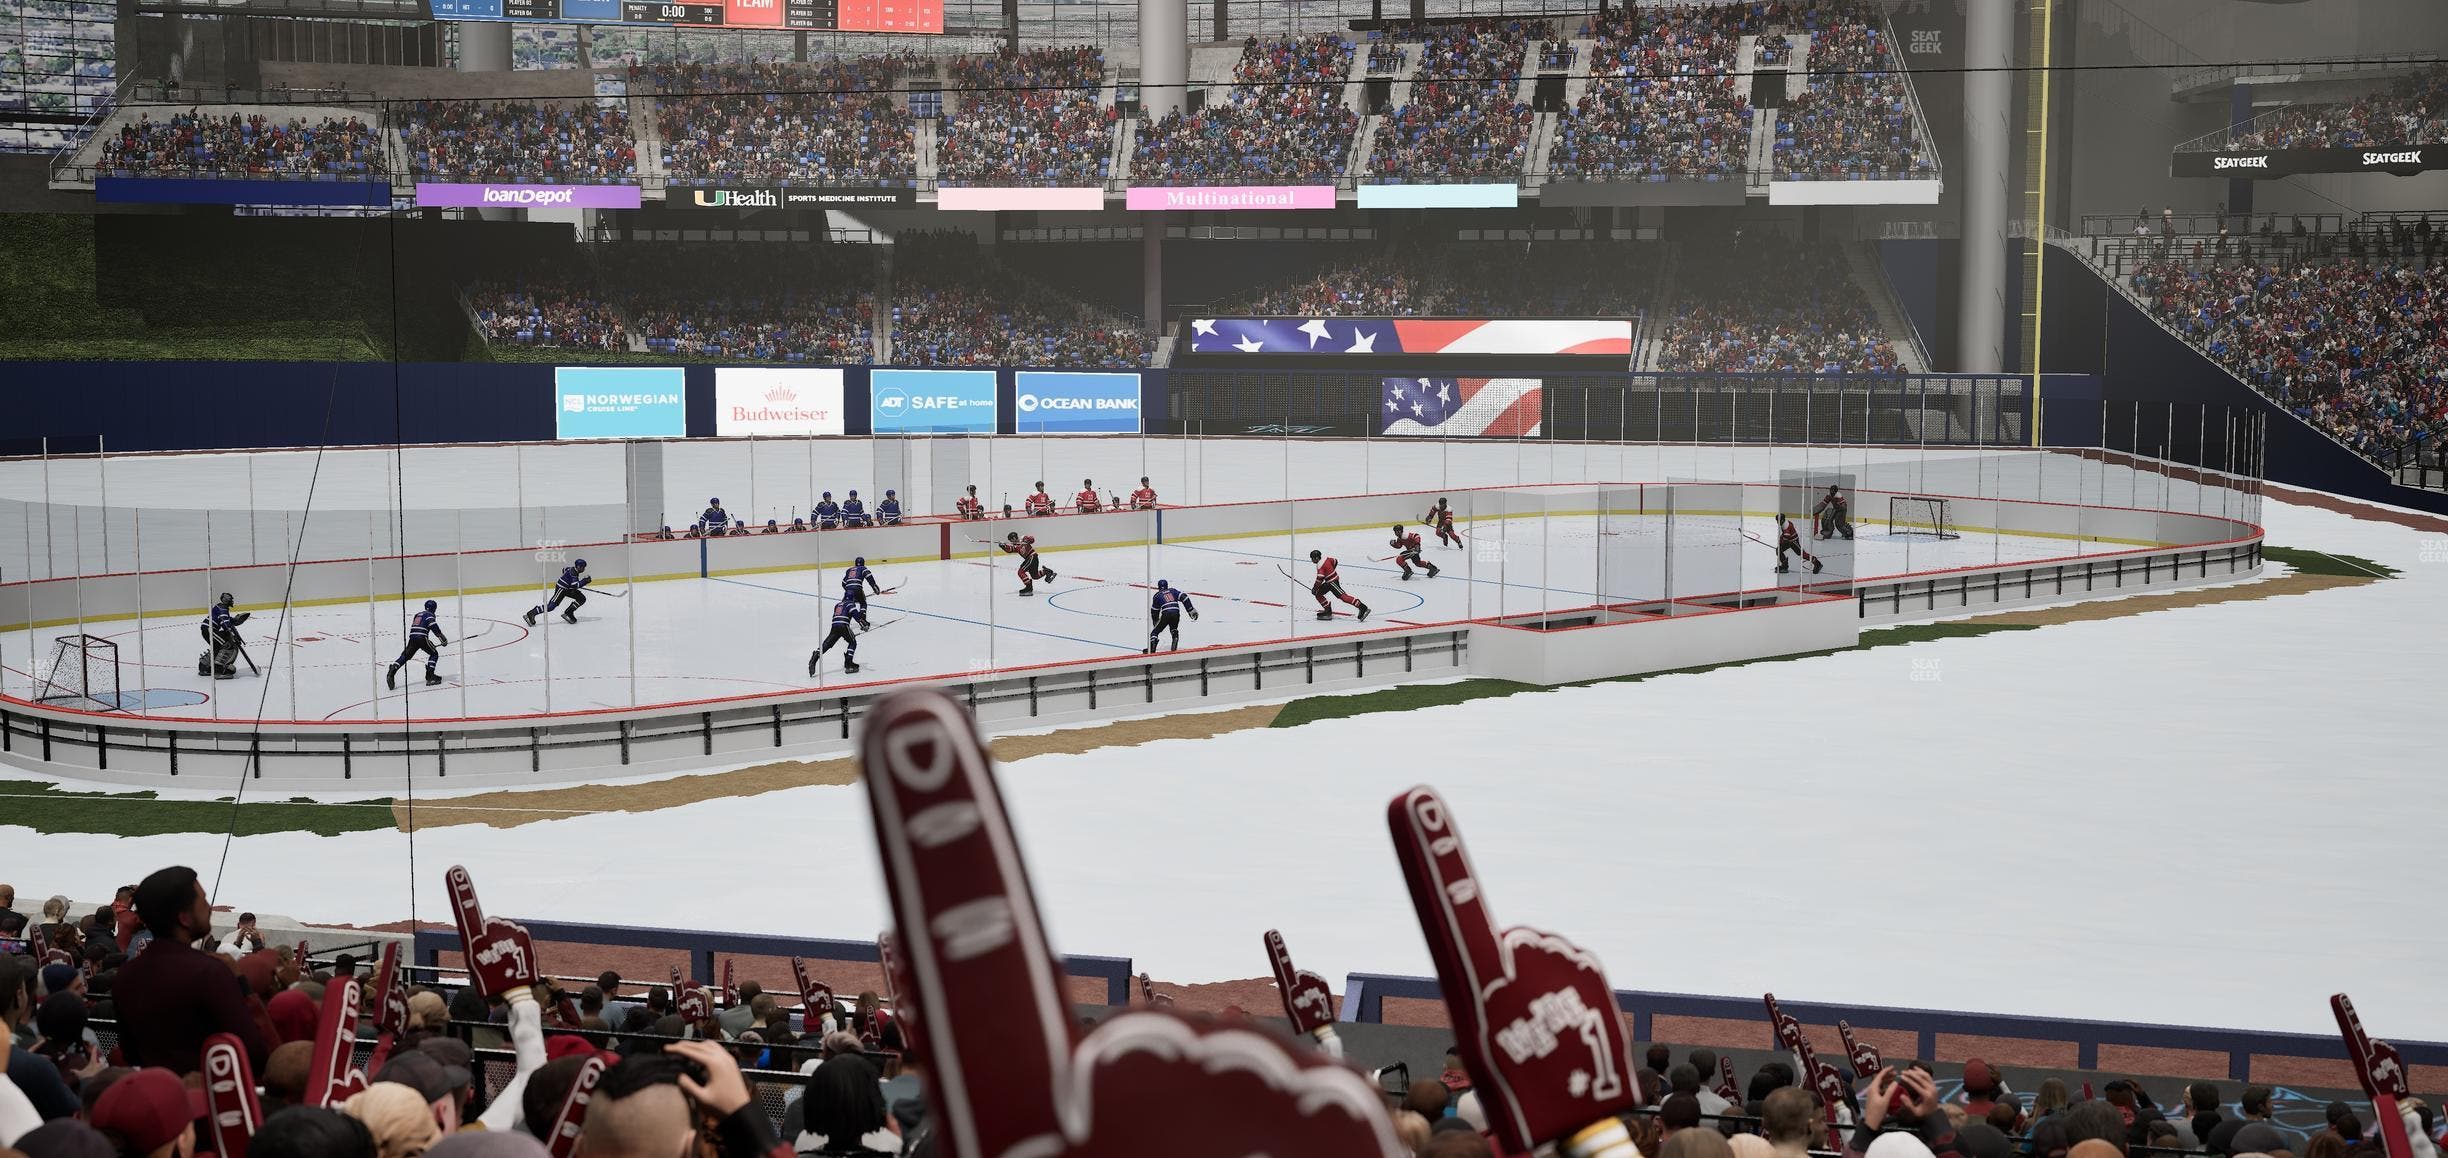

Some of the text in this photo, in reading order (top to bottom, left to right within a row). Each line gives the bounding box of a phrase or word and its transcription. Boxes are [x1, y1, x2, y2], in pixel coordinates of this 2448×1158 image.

[661, 5, 685, 17] 0:00
[2213, 155, 2268, 170] SEATGEEK
[2363, 150, 2422, 165] SEATGEEK
[483, 187, 573, 205] loanDepot
[857, 195, 897, 203] INSTITUTE
[1167, 191, 1295, 206] Multinational
[586, 394, 679, 404] NORWEGIAN
[880, 396, 994, 409] ADT SAFE at home
[1041, 398, 1138, 410] OCEAN BANK
[732, 406, 829, 422] Budweiser
